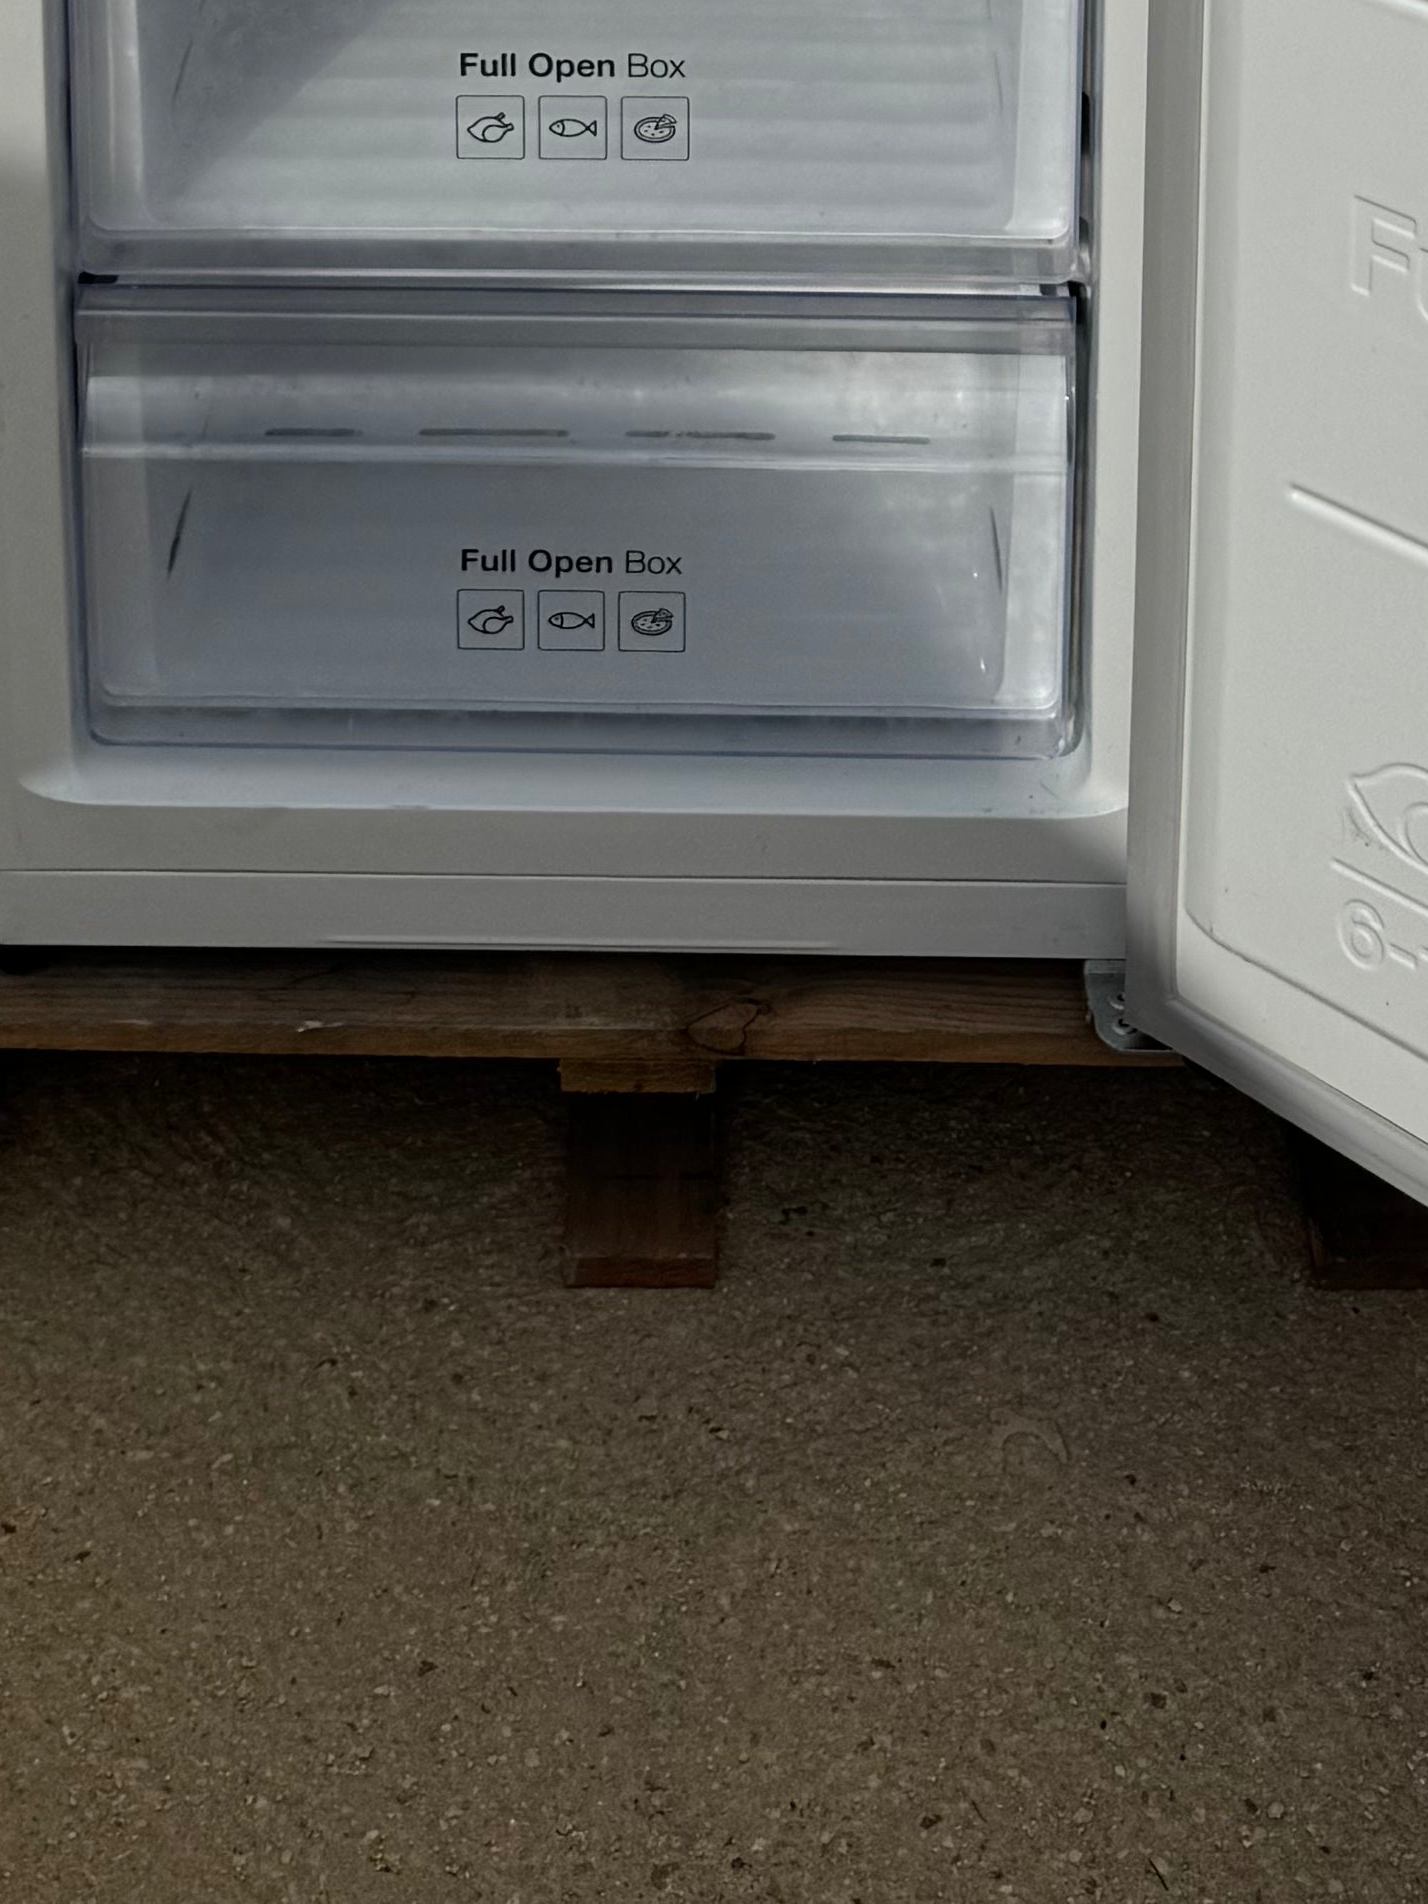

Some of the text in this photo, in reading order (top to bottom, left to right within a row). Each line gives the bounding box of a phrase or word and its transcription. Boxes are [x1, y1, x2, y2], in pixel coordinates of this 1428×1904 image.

[459, 52, 686, 83] Full Open Box
[461, 548, 682, 578] Full Open Box
